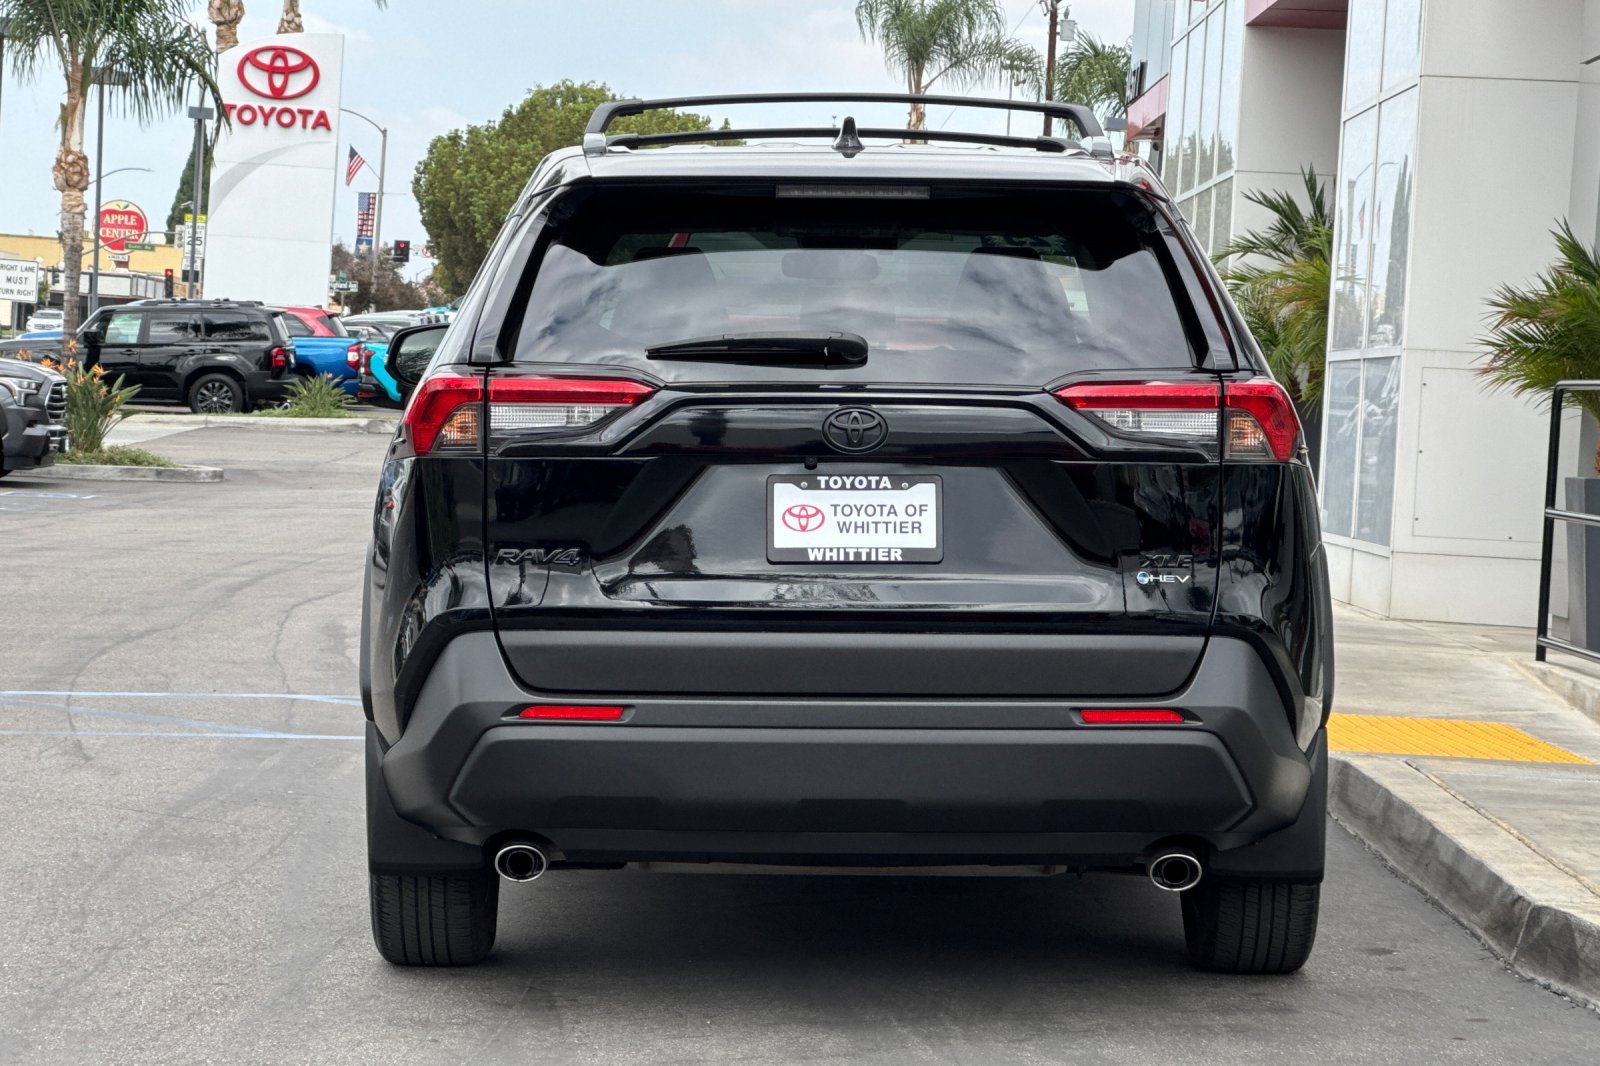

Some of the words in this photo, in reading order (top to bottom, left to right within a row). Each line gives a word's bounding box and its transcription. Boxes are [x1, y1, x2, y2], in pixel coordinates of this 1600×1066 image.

[224, 103, 332, 131] TOYOTA
[103, 213, 137, 226] APPLE
[100, 227, 139, 240] CENTER
[20, 265, 35, 273] LANE
[6, 275, 28, 285] MUST
[16, 289, 34, 297] RIGHT
[817, 476, 892, 489] TOYOTA
[830, 504, 898, 517] TOYOTA
[904, 504, 928, 517] OF
[836, 521, 923, 534] WHITTIER
[495, 548, 580, 566] RAV4
[807, 548, 903, 561] WHITTIER
[1140, 554, 1193, 568] XLE
[1150, 575, 1192, 583] HEV
